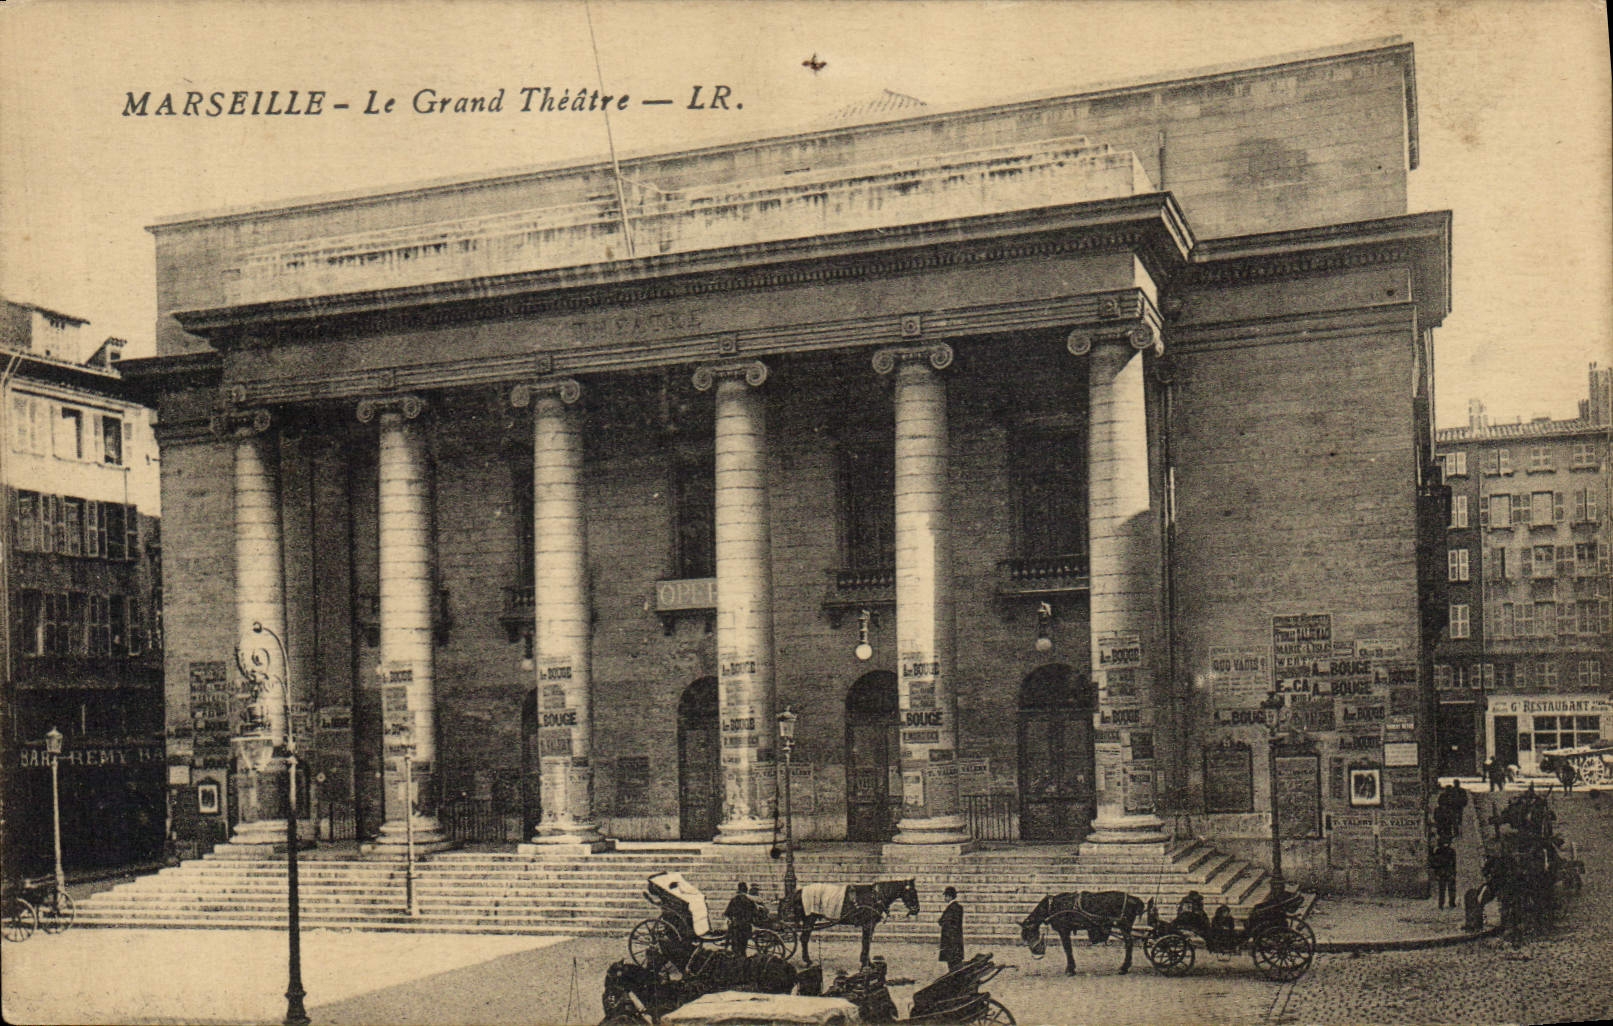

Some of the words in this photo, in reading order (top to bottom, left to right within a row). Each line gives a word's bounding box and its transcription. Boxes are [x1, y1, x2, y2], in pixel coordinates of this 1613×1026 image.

[1523, 699, 1591, 714] RESTAURANT
[543, 711, 577, 727] BOUGE
[906, 711, 943, 727] BOUGE
[1231, 710, 1267, 724] BOUG
